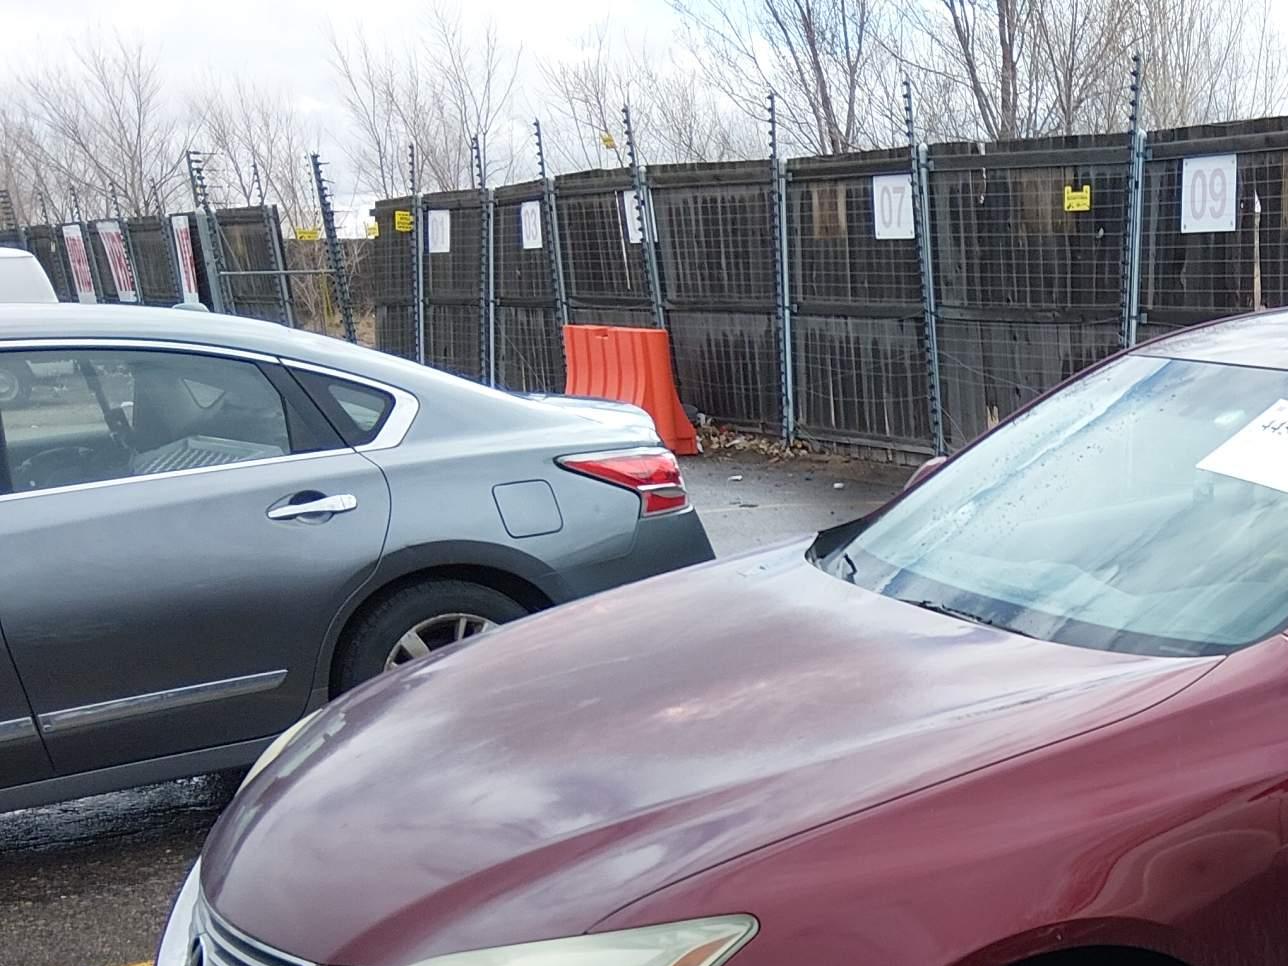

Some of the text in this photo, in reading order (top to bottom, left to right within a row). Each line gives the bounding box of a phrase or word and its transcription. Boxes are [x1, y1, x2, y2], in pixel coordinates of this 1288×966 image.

[881, 186, 906, 228] 07
[1190, 168, 1227, 220] 09
[524, 207, 539, 241] 03
